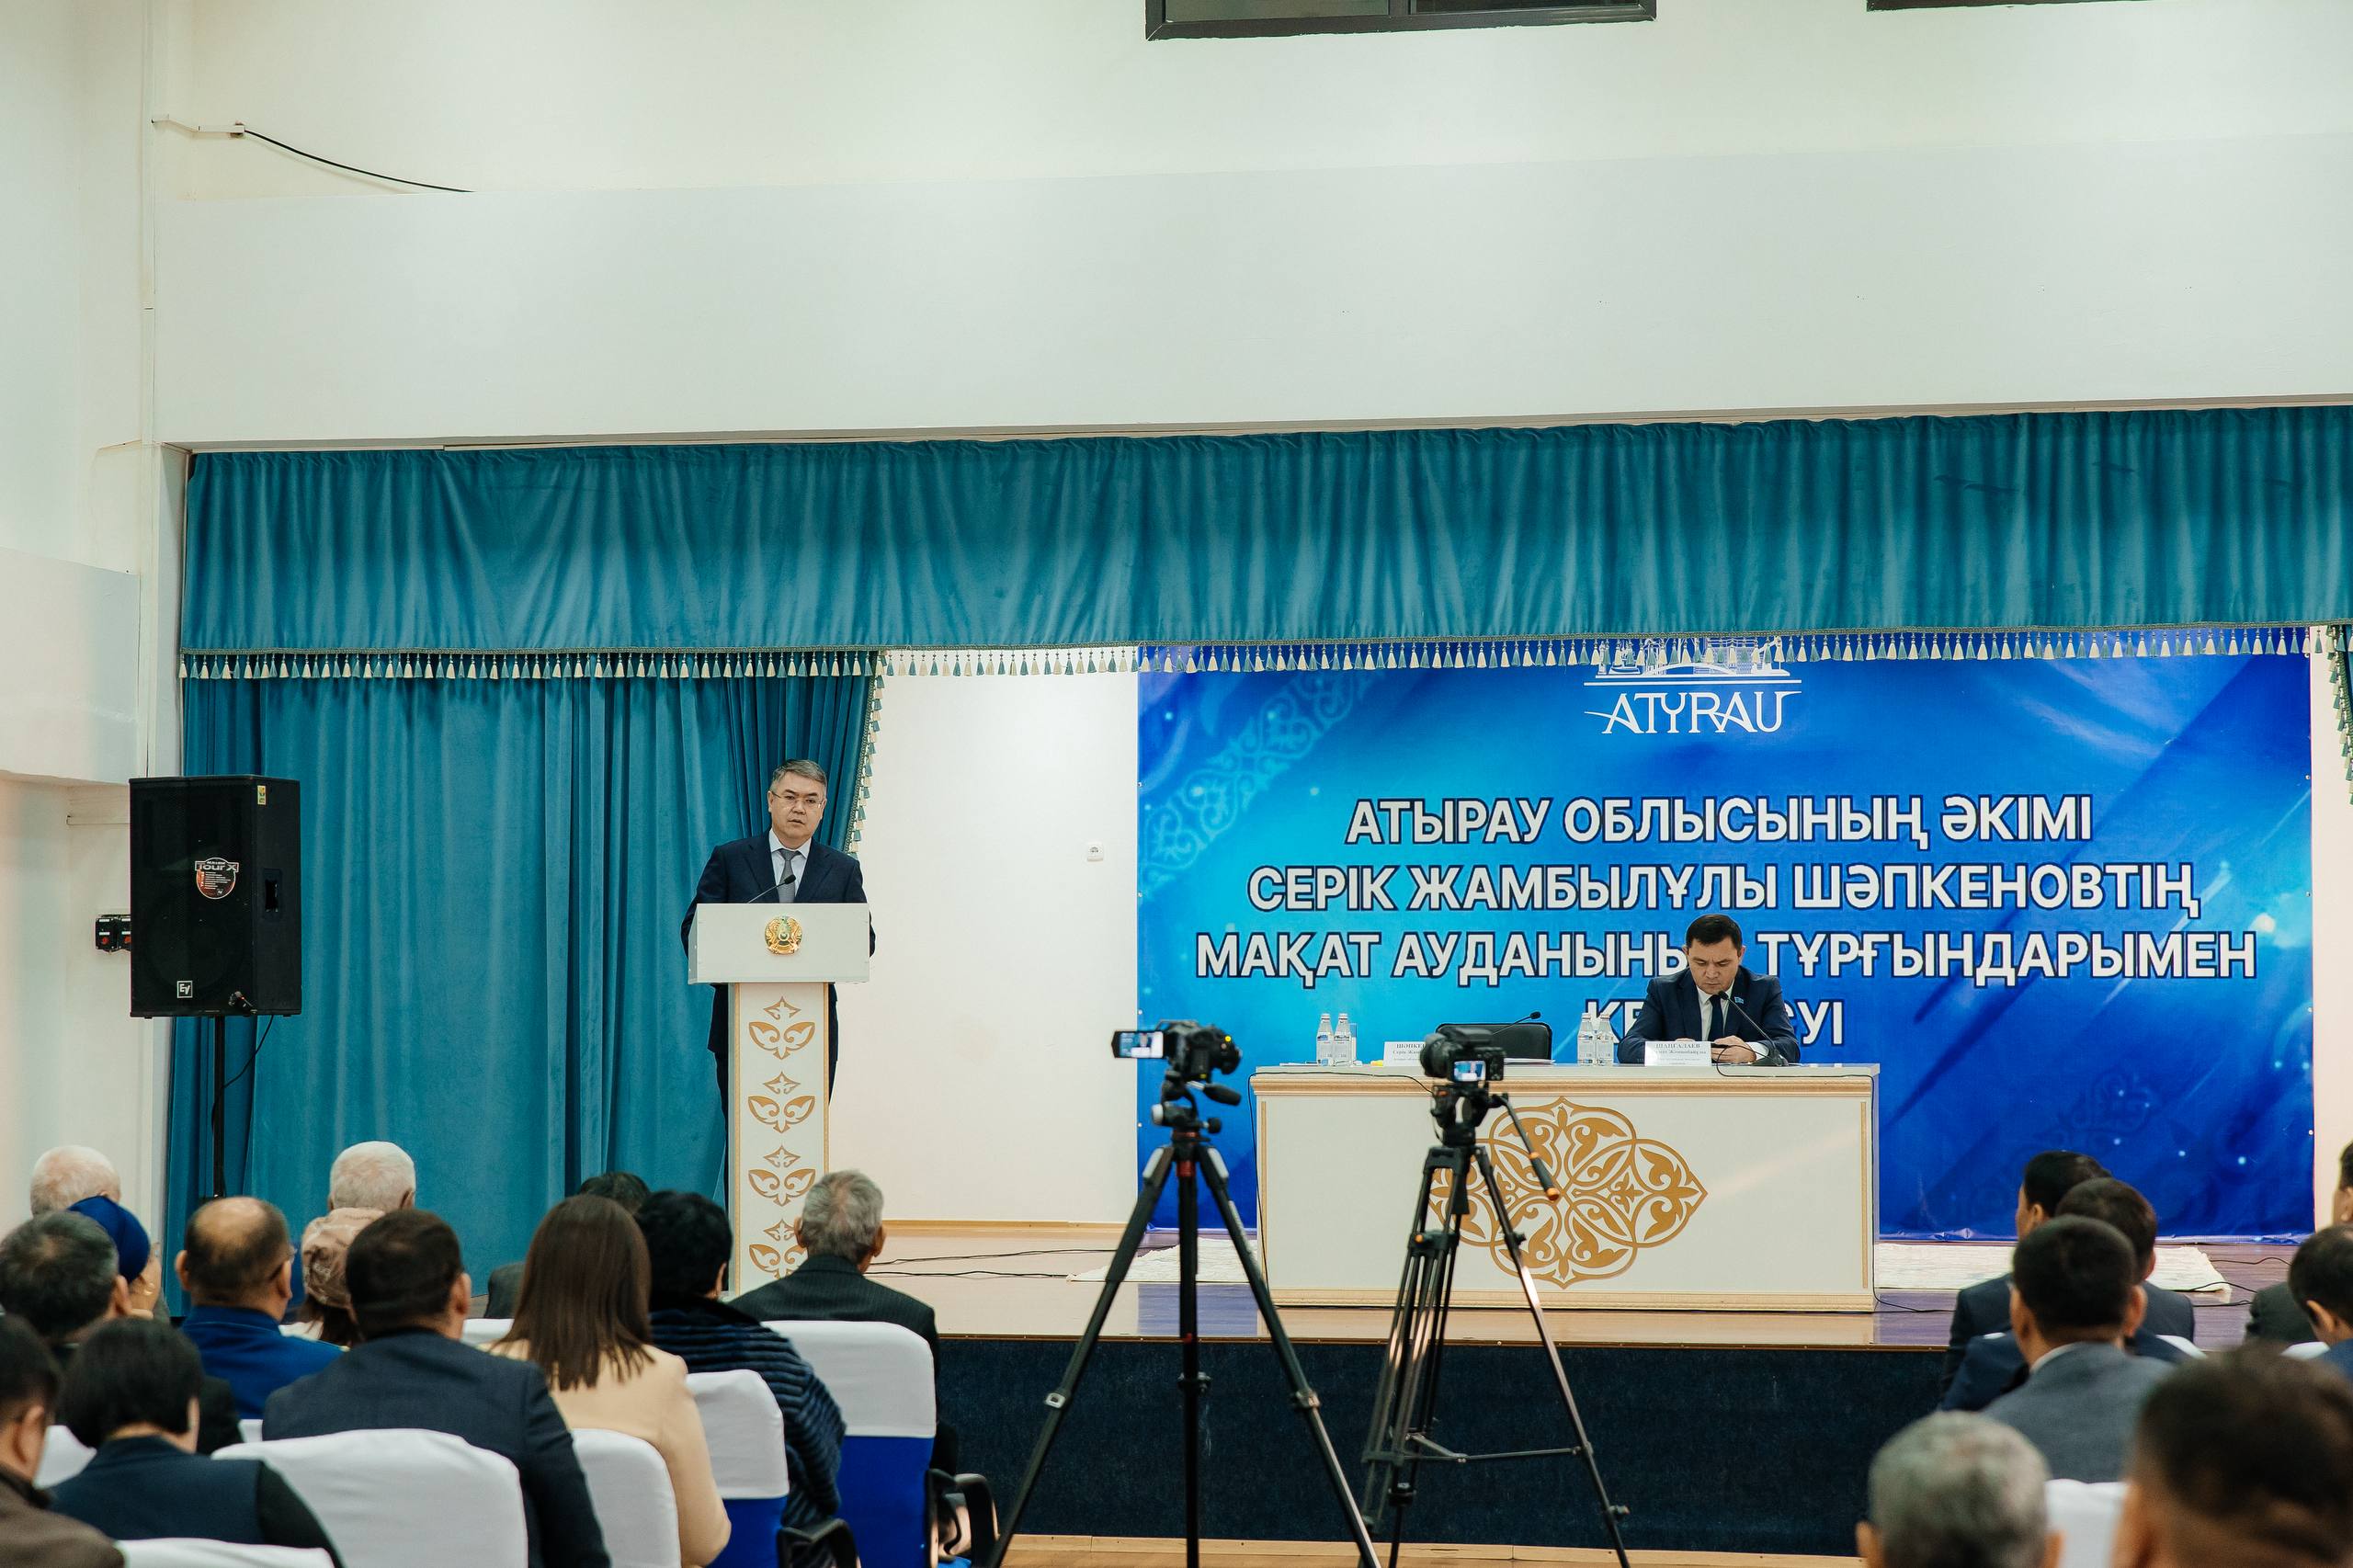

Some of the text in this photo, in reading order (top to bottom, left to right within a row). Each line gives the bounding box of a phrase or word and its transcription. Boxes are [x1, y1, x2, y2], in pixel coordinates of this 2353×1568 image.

[1584, 690, 1802, 734] ATYRAU
[1347, 796, 2091, 850] АТЫРАУ ОБЛЫСЫНЫҢ ӘКІМІ
[1250, 864, 2199, 925] СЕРІК ЖАМБЫЛҰЛЫ ШӘПКЕНОВТІҢ
[1198, 933, 2256, 987] МАҚАТ АУДАНЫНЫ ТҰРҒЫНДАРЫМЕН
